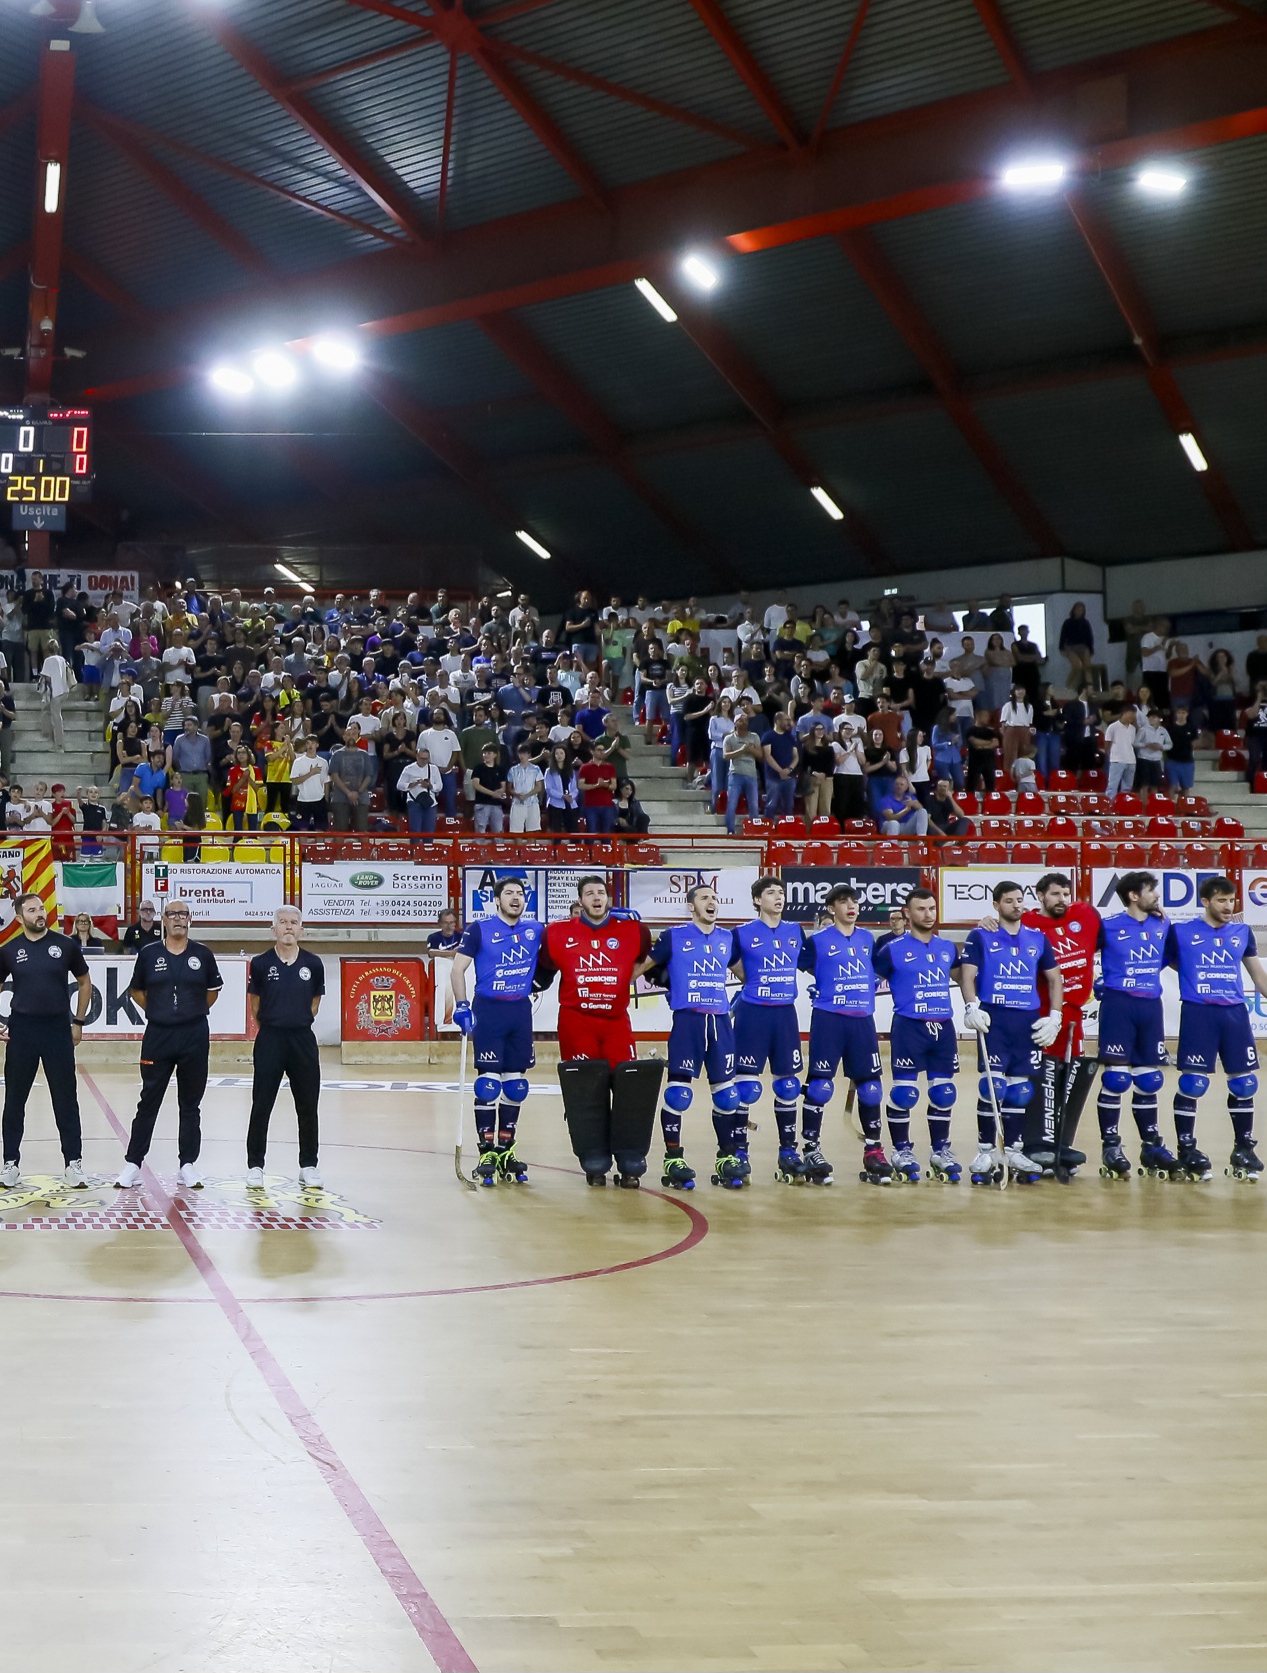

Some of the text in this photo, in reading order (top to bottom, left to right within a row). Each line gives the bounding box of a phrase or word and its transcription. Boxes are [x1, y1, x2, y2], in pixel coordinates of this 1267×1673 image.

[19, 426, 34, 452] 0
[73, 427, 88, 452] 0
[0, 453, 13, 473] 0
[39, 459, 43, 473] 1
[75, 454, 87, 474] 0
[20, 505, 58, 515] Uscita
[88, 574, 134, 591] DONA!
[158, 866, 166, 876] T
[392, 874, 442, 882] Scremin
[158, 880, 165, 890] F
[392, 882, 442, 890] bassano
[180, 887, 225, 898] brenta
[364, 967, 392, 977] BASSANO
[392, 968, 403, 977] DEL
[402, 975, 416, 1000] GRAPPA
[792, 1049, 801, 1063] 8
[872, 1052, 881, 1068] 11
[1030, 1051, 1042, 1064] 21
[1246, 1046, 1255, 1060] 6
[1042, 1060, 1056, 1143] MENEGHINI
